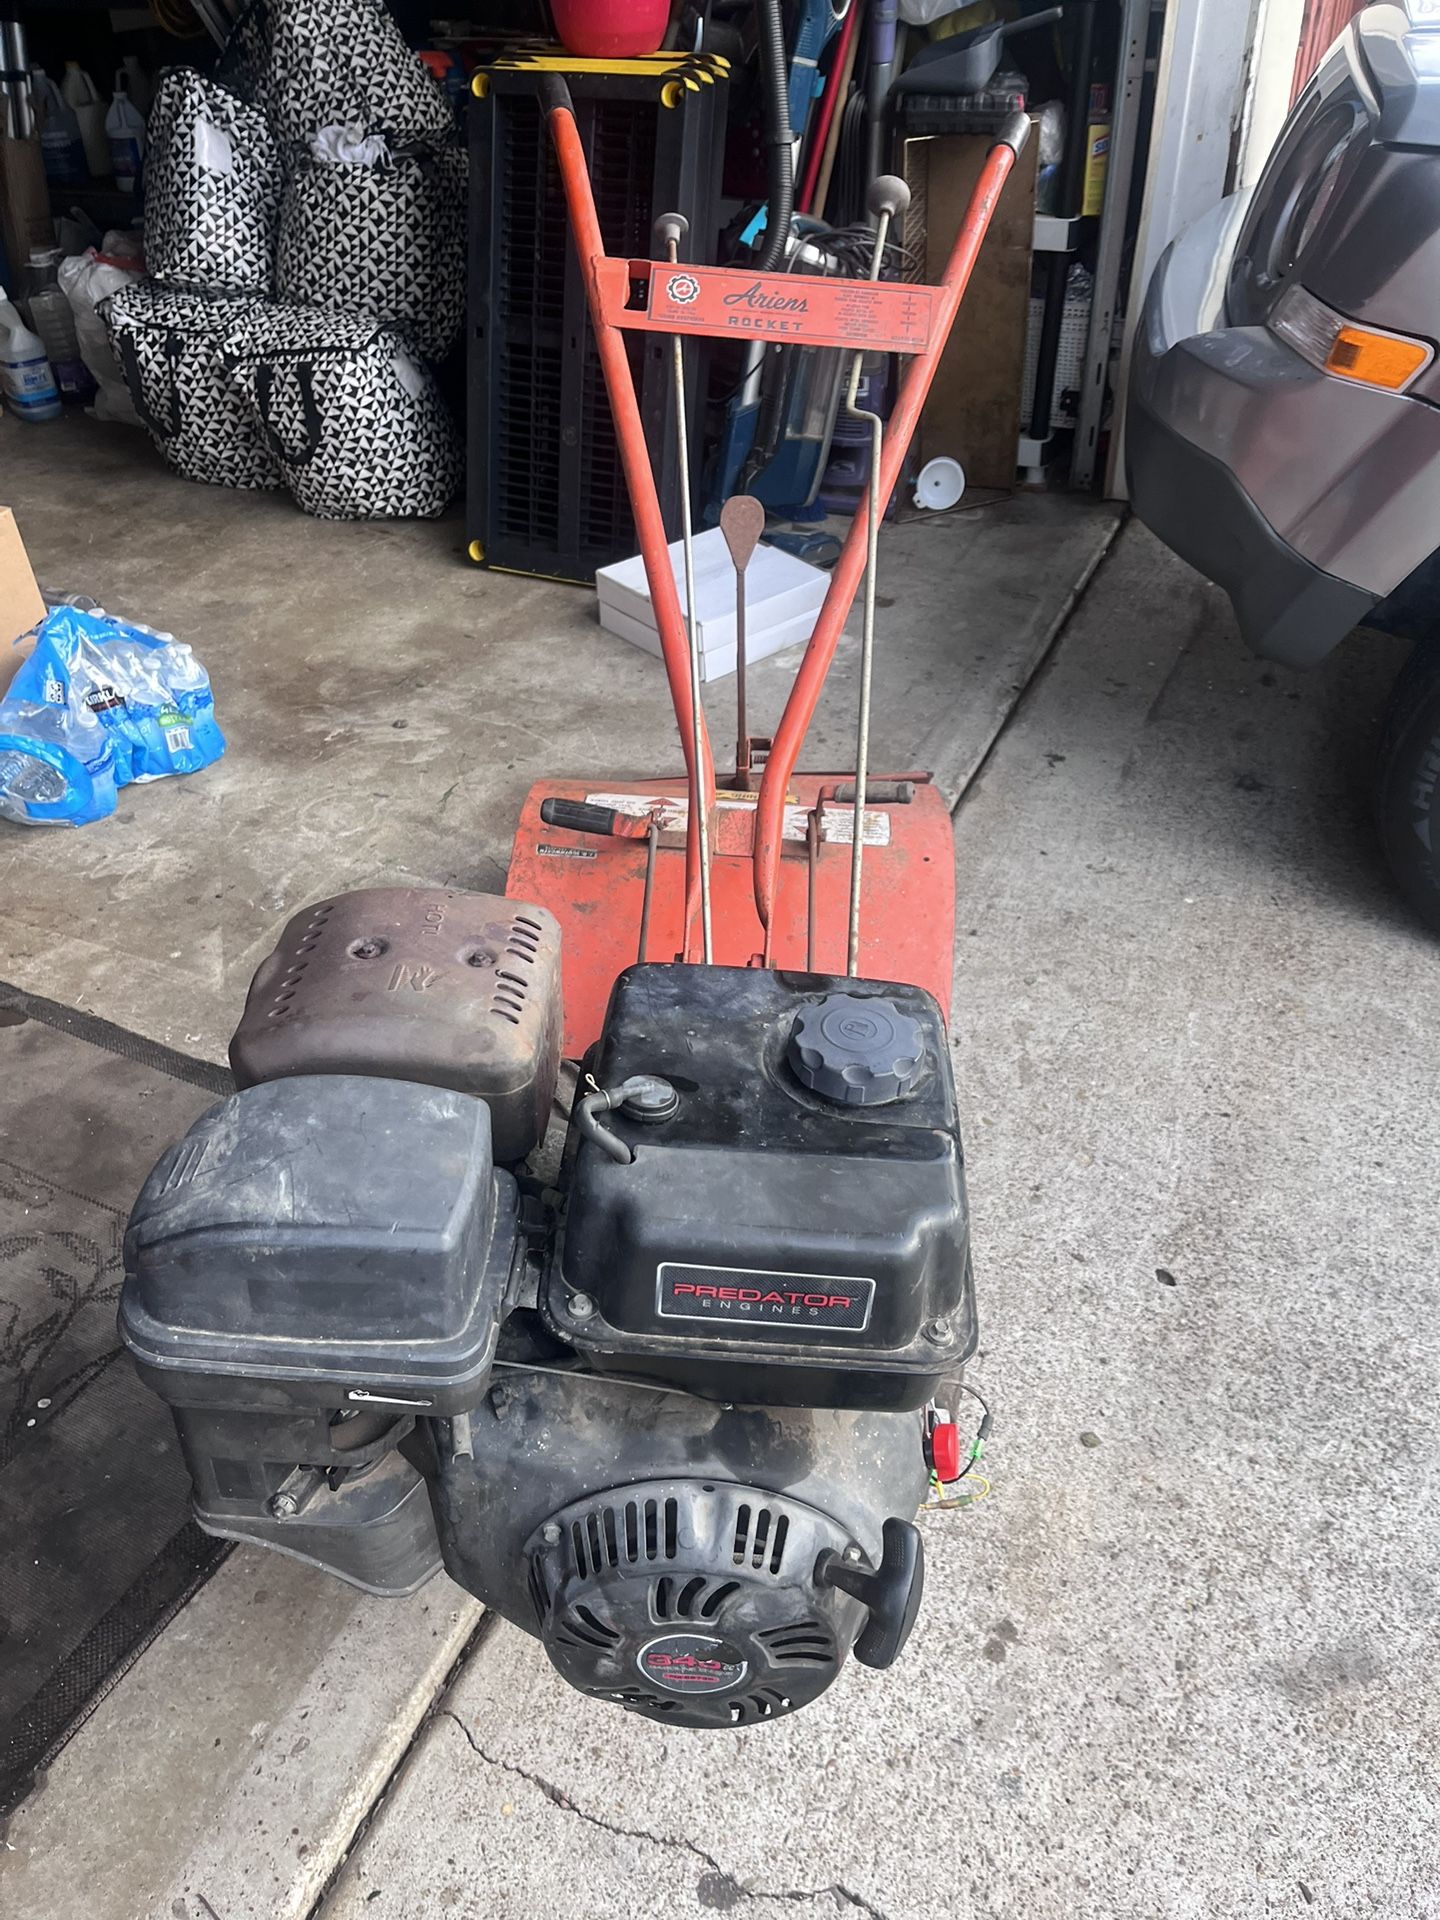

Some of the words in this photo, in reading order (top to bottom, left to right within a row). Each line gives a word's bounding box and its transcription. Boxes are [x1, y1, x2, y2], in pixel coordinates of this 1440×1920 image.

[723, 281, 808, 312] Ariens
[728, 316, 803, 331] ROCKET
[674, 1283, 851, 1308] PREDATOR
[702, 1299, 819, 1316] ENGINES
